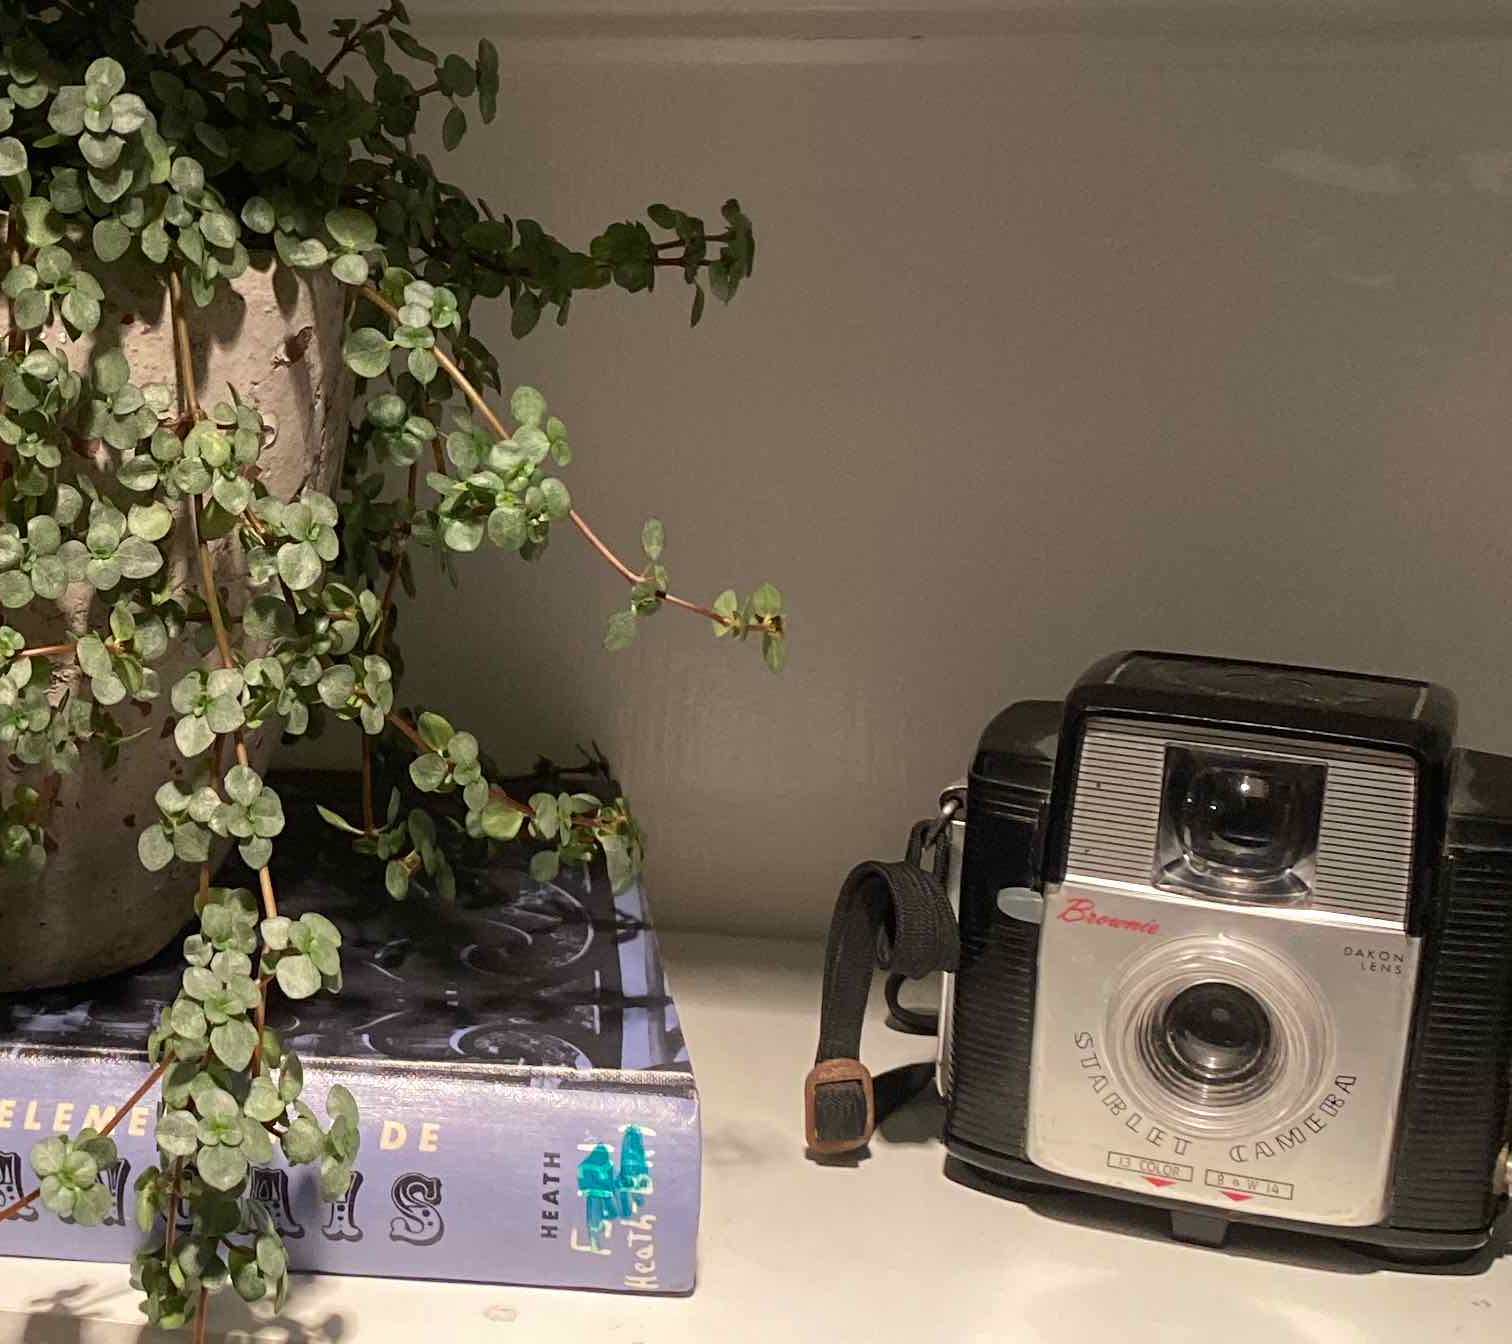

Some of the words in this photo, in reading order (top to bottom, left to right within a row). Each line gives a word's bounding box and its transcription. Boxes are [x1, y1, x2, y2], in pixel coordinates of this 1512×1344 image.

[1056, 897, 1161, 935] Brownie
[1342, 945, 1405, 963] DAKON
[1359, 959, 1403, 975] LENS
[1073, 1030, 1193, 1157] STARLET
[1228, 1073, 1358, 1163] CAMERA
[379, 1118, 442, 1153] DE
[1139, 1158, 1182, 1179] COLOR
[540, 1150, 562, 1240] HEATH
